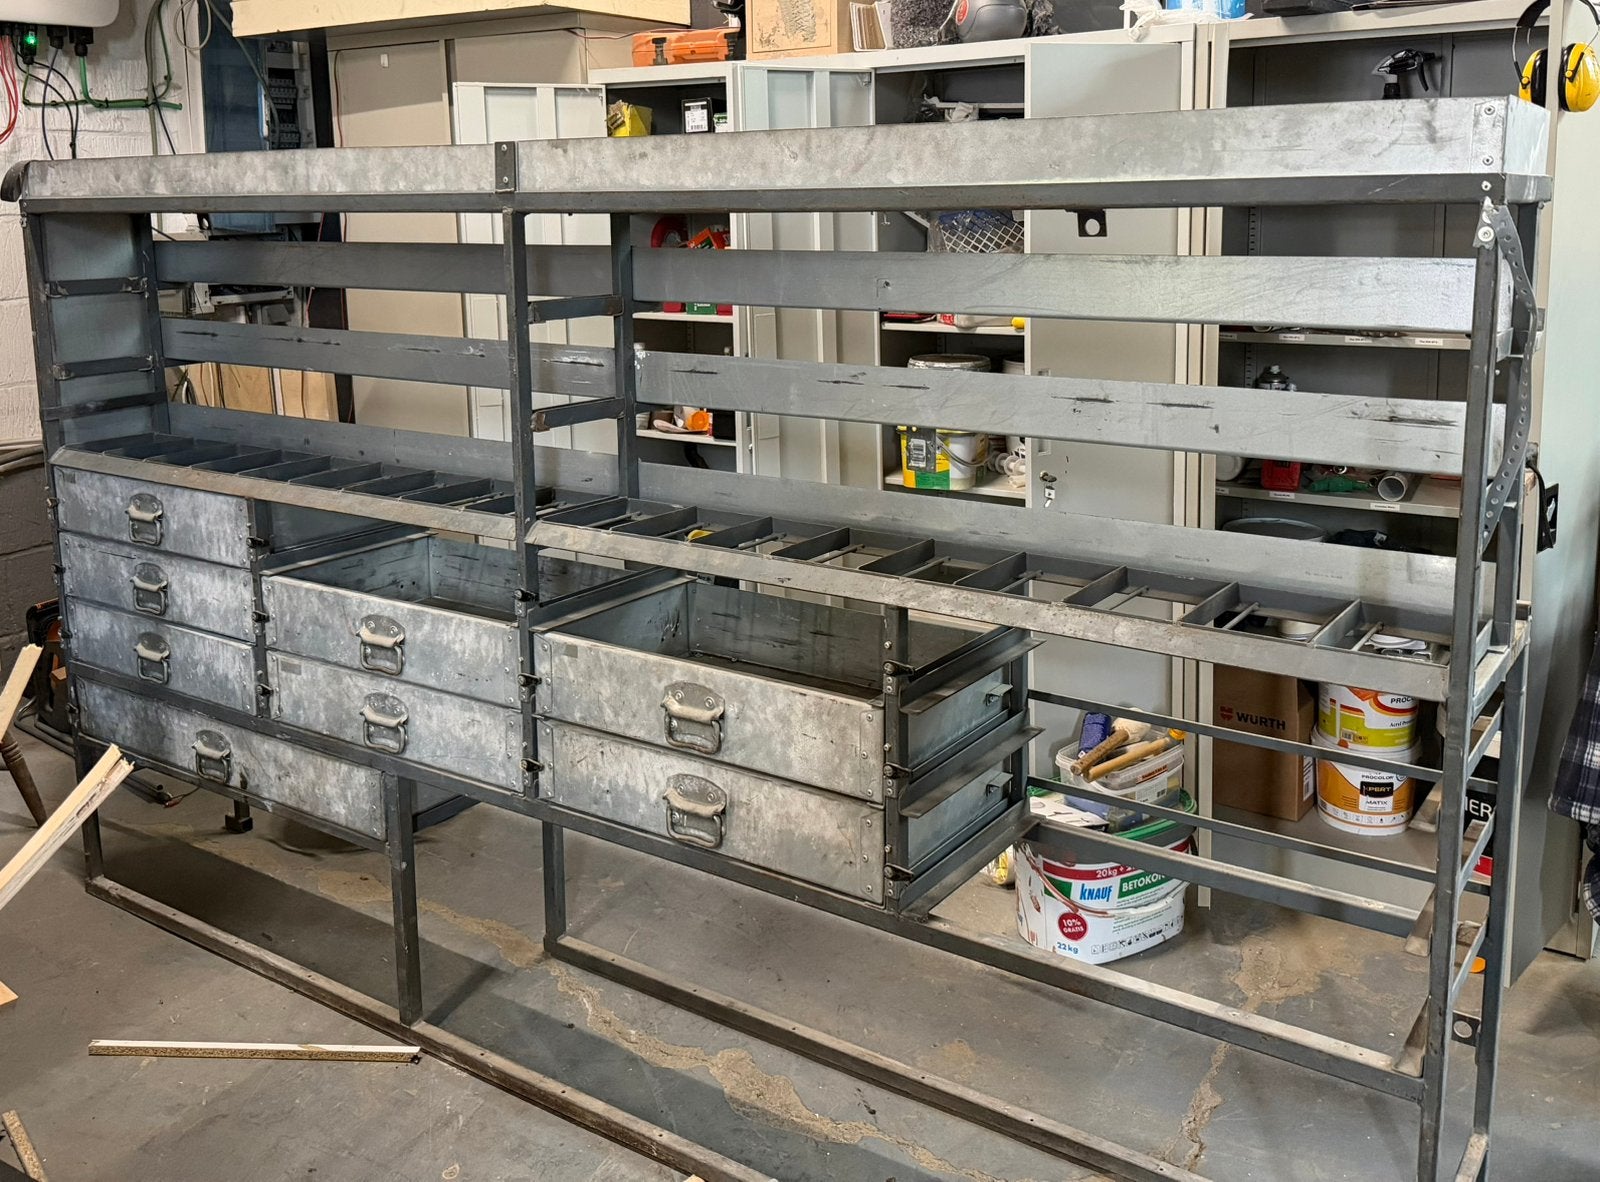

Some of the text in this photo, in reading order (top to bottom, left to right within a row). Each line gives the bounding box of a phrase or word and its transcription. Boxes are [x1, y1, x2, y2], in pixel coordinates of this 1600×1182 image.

[1390, 696, 1414, 704] PROC
[1095, 867, 1118, 878] 20kg
[1080, 883, 1113, 902] KNAUF
[1062, 918, 1082, 928] 10%
[1062, 926, 1085, 934] GRATIS
